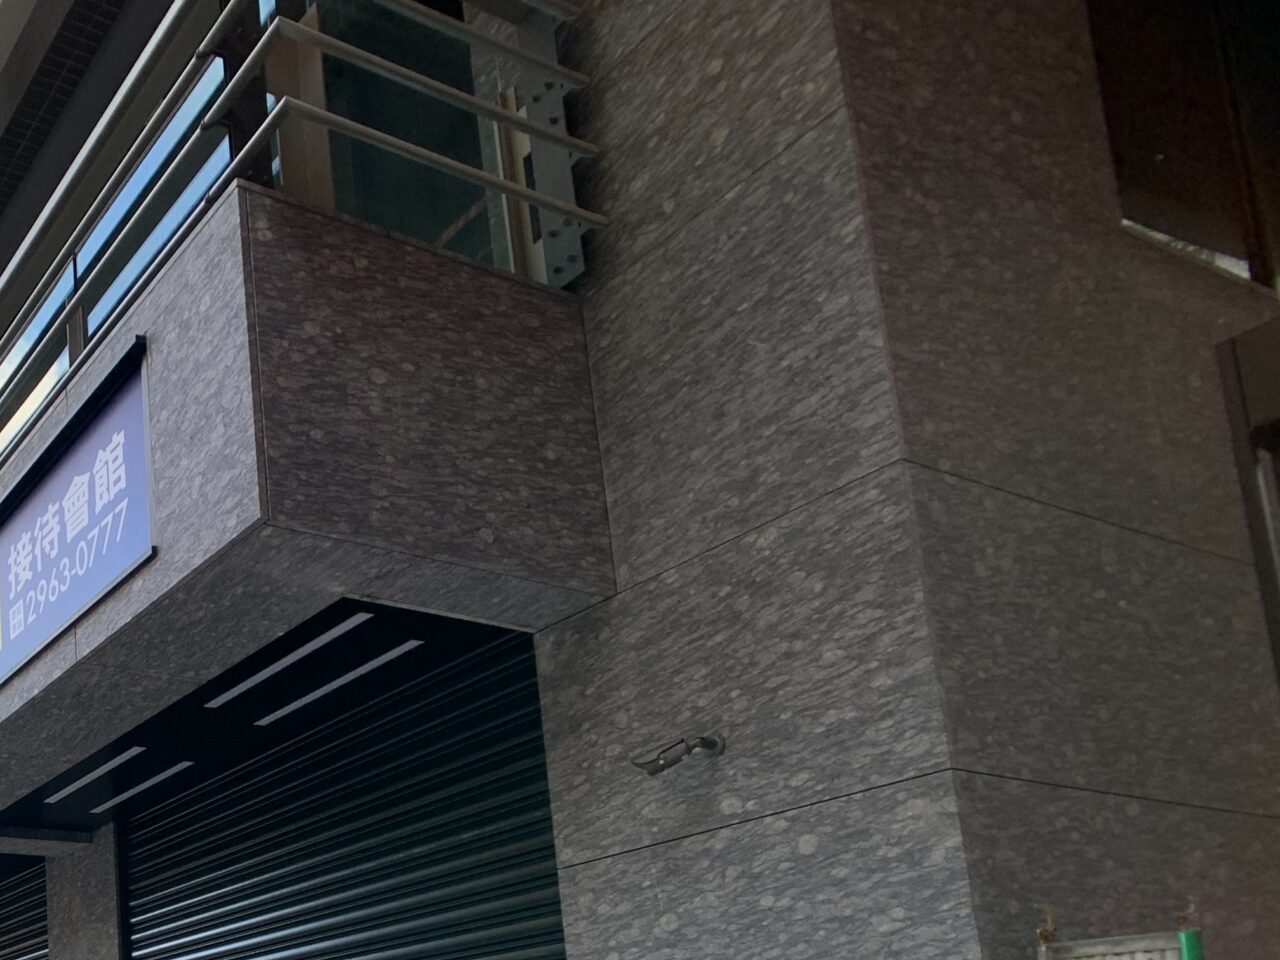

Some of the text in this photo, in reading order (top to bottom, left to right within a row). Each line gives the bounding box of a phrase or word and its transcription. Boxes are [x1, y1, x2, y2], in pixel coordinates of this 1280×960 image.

[8, 430, 127, 600] 接待會館
[26, 497, 129, 625] 2963-0777
